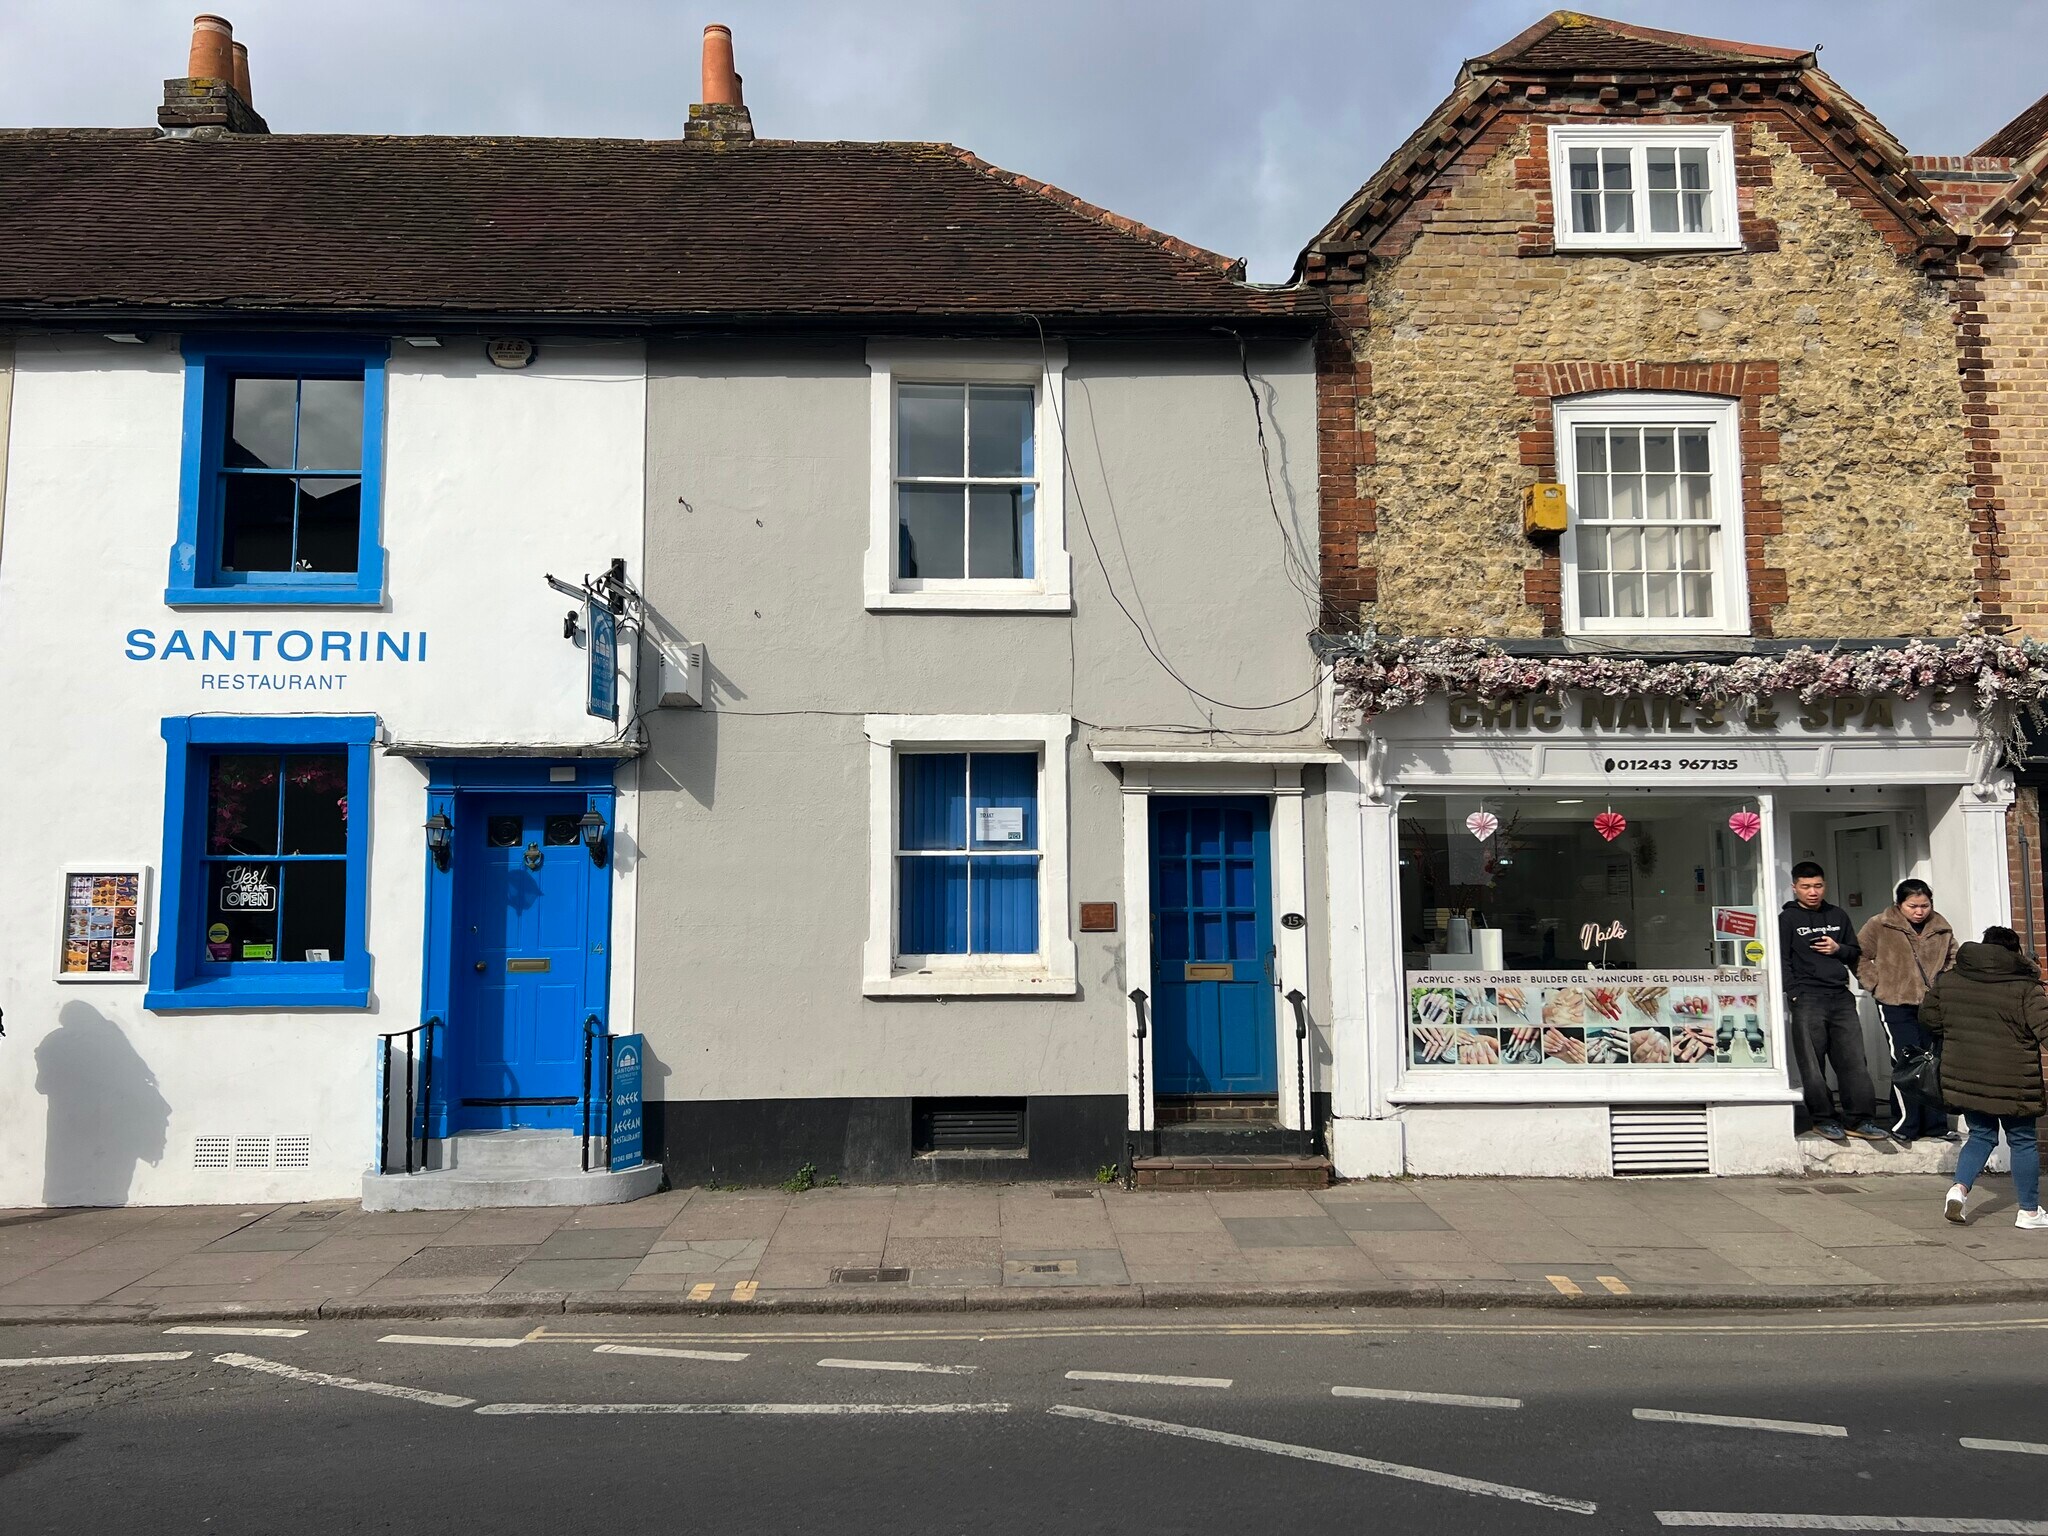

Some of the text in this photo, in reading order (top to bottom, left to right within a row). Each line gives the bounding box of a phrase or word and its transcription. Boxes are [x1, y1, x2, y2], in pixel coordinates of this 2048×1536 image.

[124, 628, 427, 662] SANTORINI
[201, 674, 348, 690] RESTAURANT
[1450, 696, 1894, 729] CHIC NAILS & SPA
[1617, 759, 1738, 770] 01243 967135
[226, 865, 268, 890] Yes!
[240, 884, 268, 892] WE ARE
[226, 892, 269, 906] OPEN
[1288, 916, 1299, 926] 15
[1581, 920, 1627, 950] Nails
[1417, 974, 1757, 984] ACRYLIC SNS OMBRE BUILDER GEL MANICURE GEL POLISH PEDICURE
[614, 1065, 640, 1075] SANTORINI
[616, 1091, 639, 1106] GREEK
[622, 1108, 632, 1117] AND
[613, 1117, 640, 1134] AEGEAN
[613, 1131, 640, 1145] RESTAURANT
